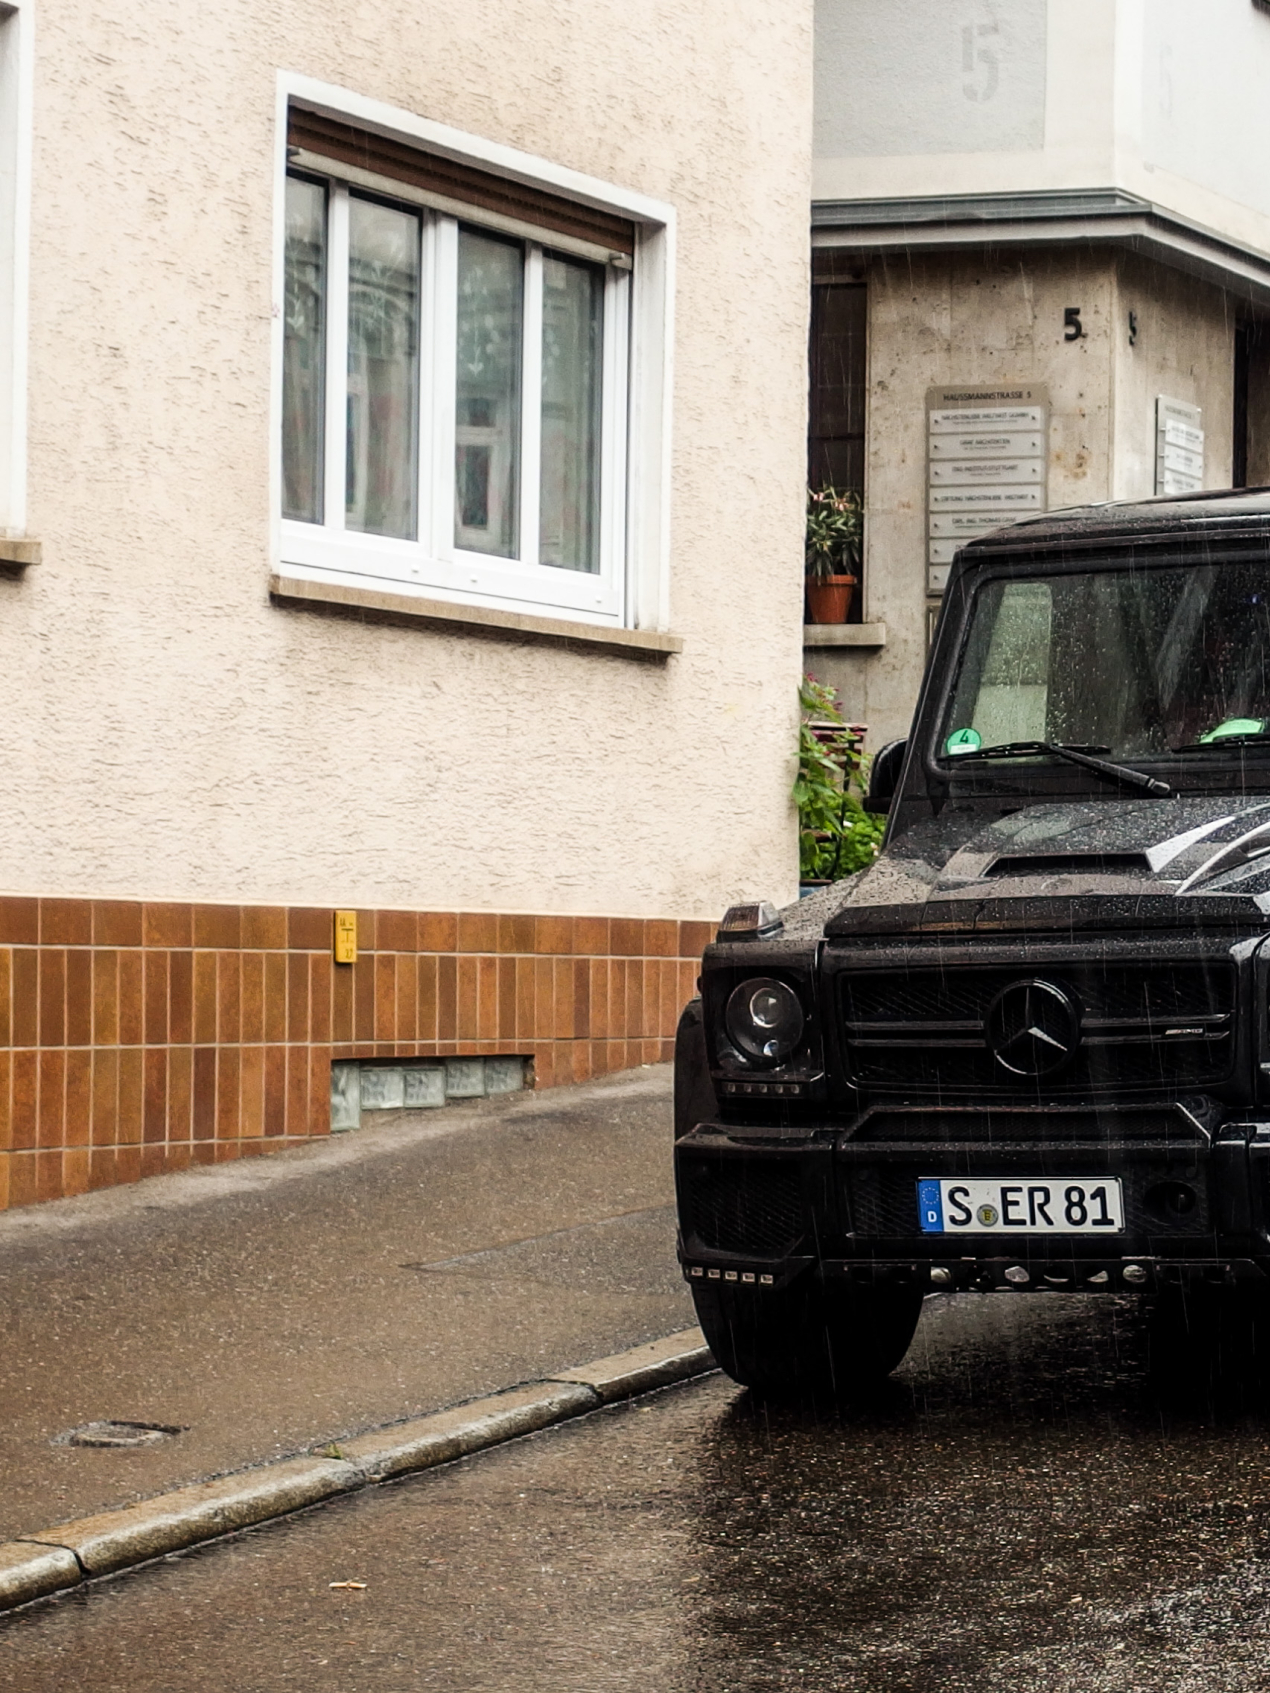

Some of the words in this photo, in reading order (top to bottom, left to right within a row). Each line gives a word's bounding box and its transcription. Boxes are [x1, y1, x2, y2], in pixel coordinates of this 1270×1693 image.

[962, 24, 999, 101] 5
[1064, 308, 1083, 341] 5
[943, 391, 1023, 401] HAUSSMANNSTRASSE
[959, 730, 969, 744] 4
[927, 1210, 938, 1223] D
[947, 1186, 973, 1227] S
[1000, 1186, 1054, 1226] ER
[1064, 1186, 1115, 1227] 81
